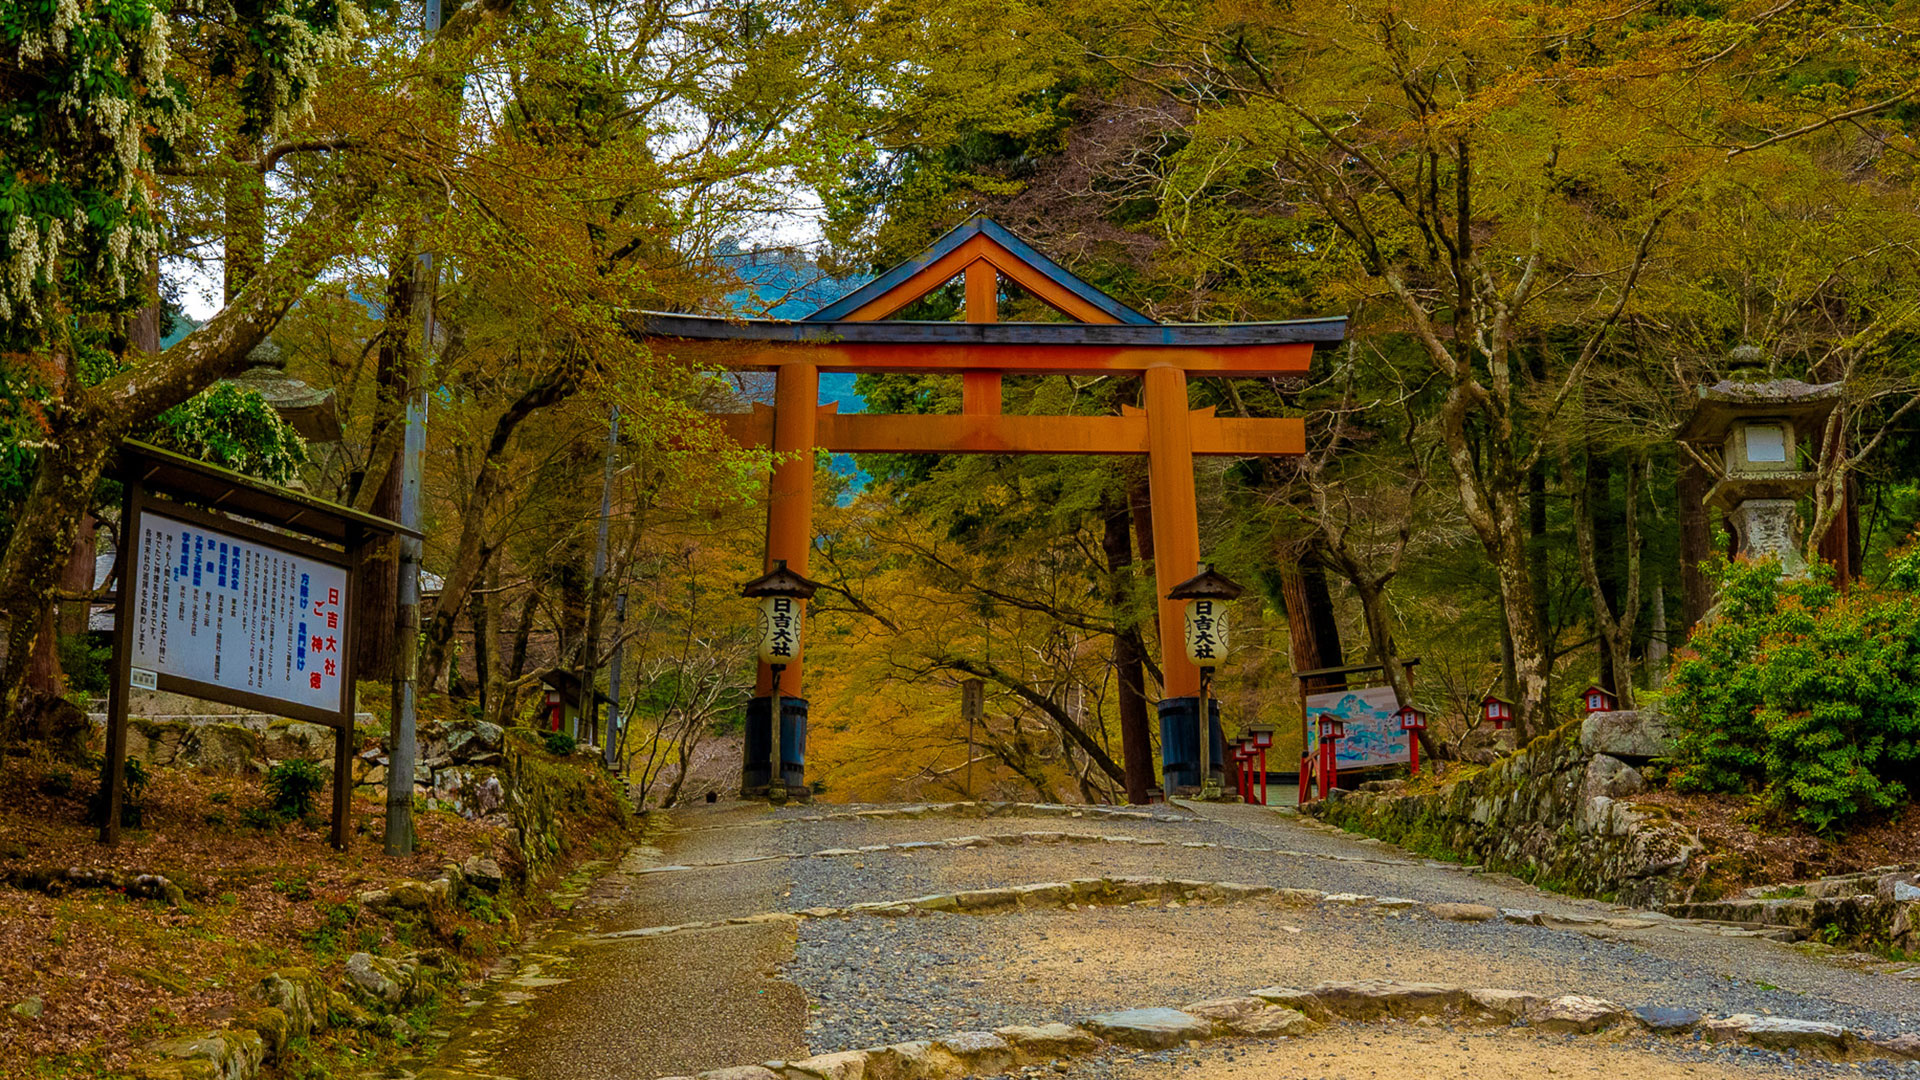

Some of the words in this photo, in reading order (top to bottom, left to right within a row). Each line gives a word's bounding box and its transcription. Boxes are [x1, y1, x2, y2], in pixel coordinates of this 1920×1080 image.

[179, 531, 190, 577] 学業成就
[205, 538, 215, 573] 安産
[231, 545, 241, 591] 家内安全
[296, 573, 310, 672] 方除け・鬼門除け
[309, 599, 325, 690] ご神徳
[323, 587, 339, 677] 日吉大社
[770, 598, 793, 657] 日吉大社
[1193, 601, 1217, 660] 日吉大社
